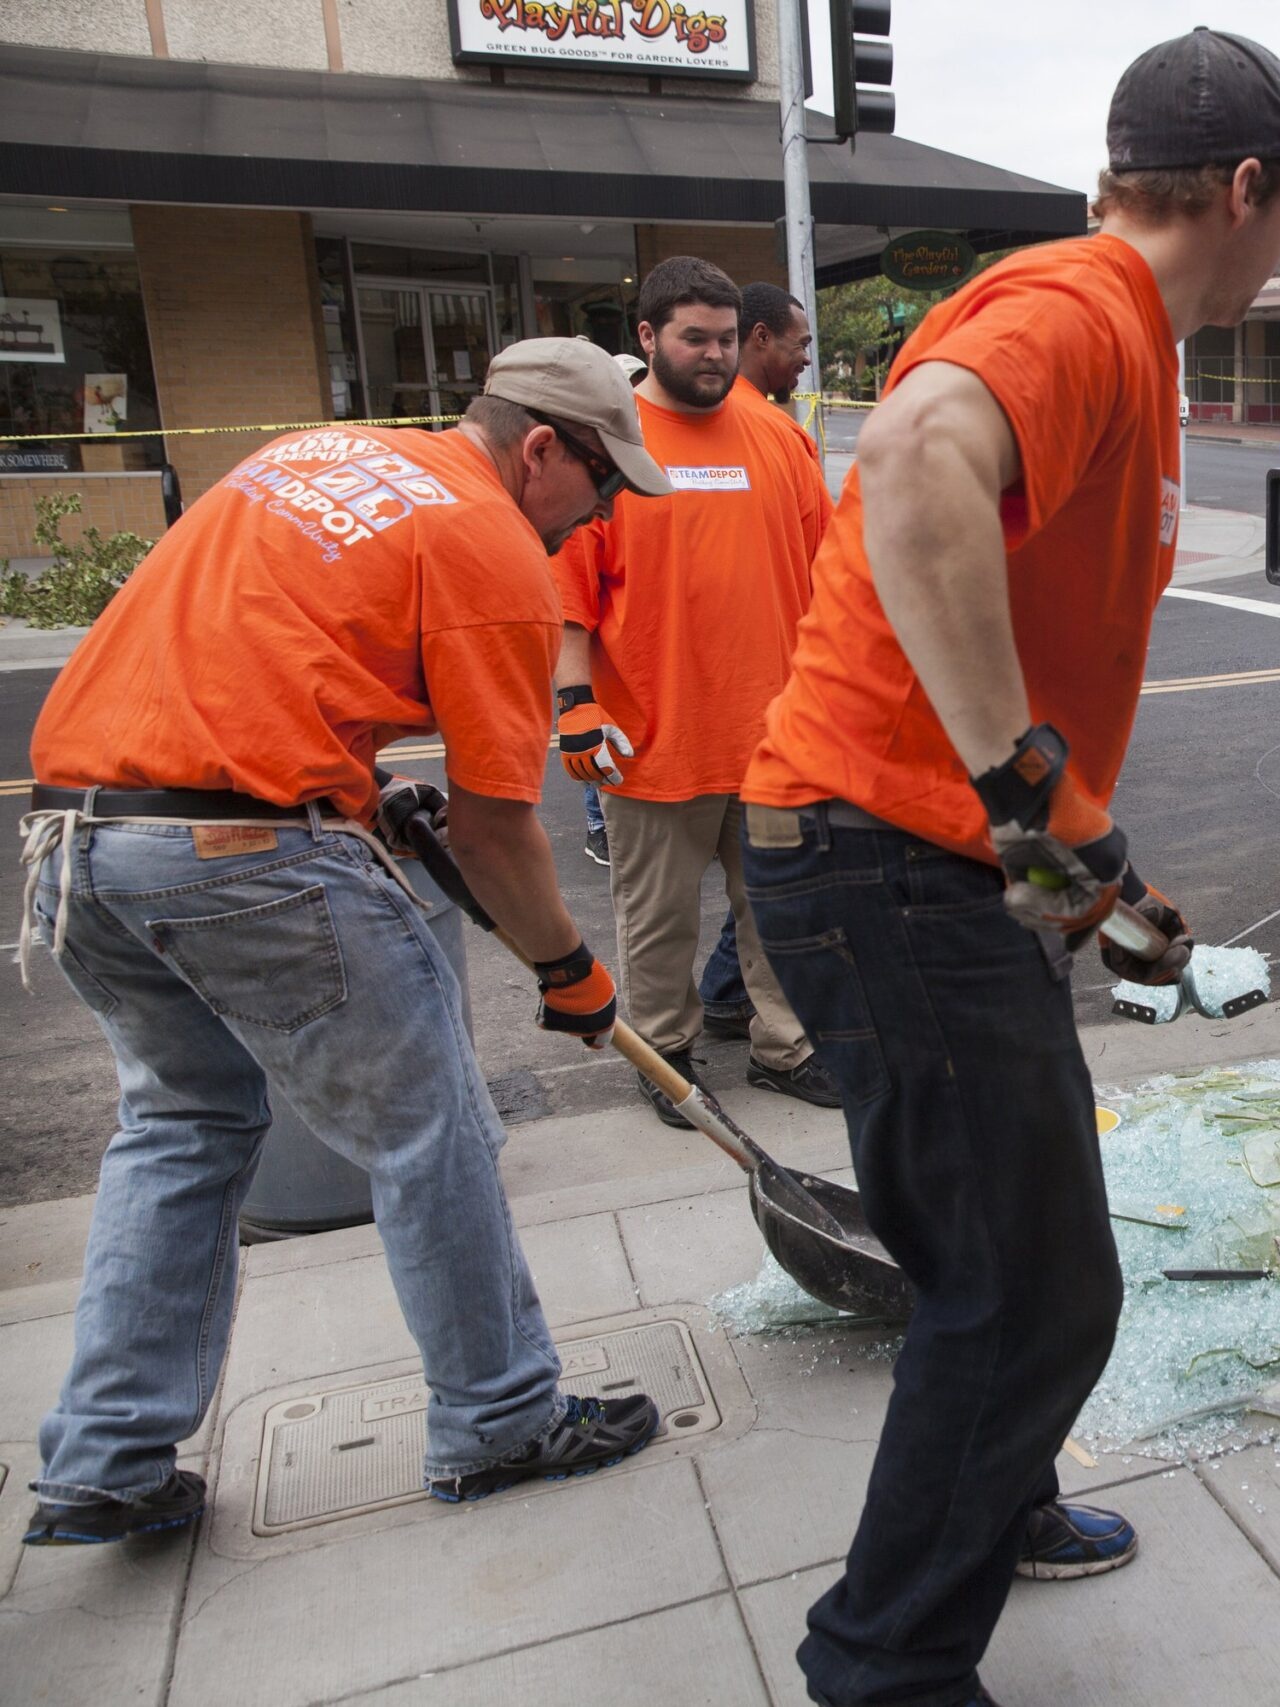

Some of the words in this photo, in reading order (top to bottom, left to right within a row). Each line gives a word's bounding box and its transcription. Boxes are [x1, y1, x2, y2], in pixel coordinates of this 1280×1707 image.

[630, 0, 728, 53] Digs
[486, 43, 527, 53] GREEN
[531, 46, 555, 55] BUG
[610, 52, 633, 61] FOR
[636, 53, 683, 64] GARDEN
[686, 58, 729, 67] LOVERS
[260, 438, 380, 460] HOME
[678, 469, 743, 479] TEAMDEPOT
